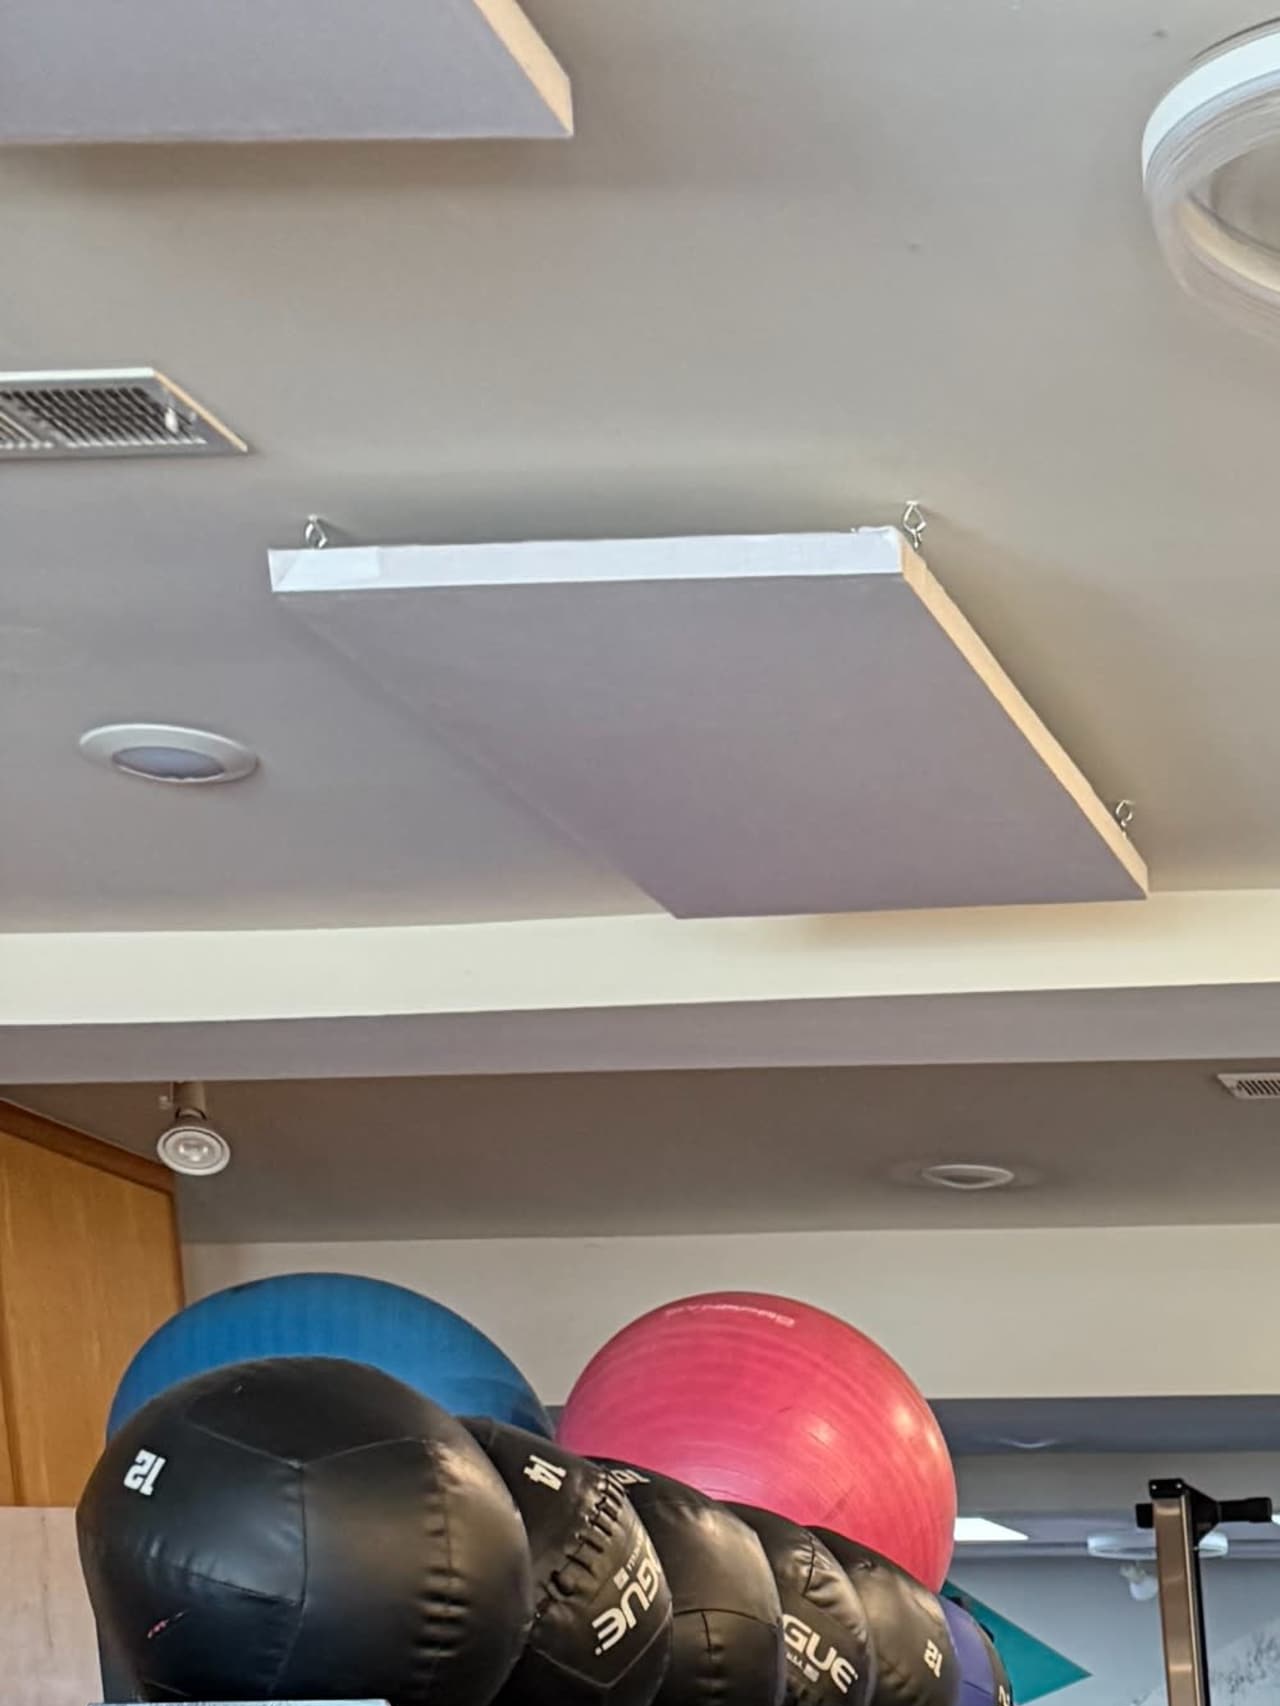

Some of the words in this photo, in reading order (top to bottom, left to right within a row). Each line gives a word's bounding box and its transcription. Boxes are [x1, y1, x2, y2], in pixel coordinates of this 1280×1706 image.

[124, 1449, 166, 1496] 12
[523, 1455, 567, 1491] 14
[592, 1556, 660, 1651] GUE
[782, 1614, 856, 1693] GUE
